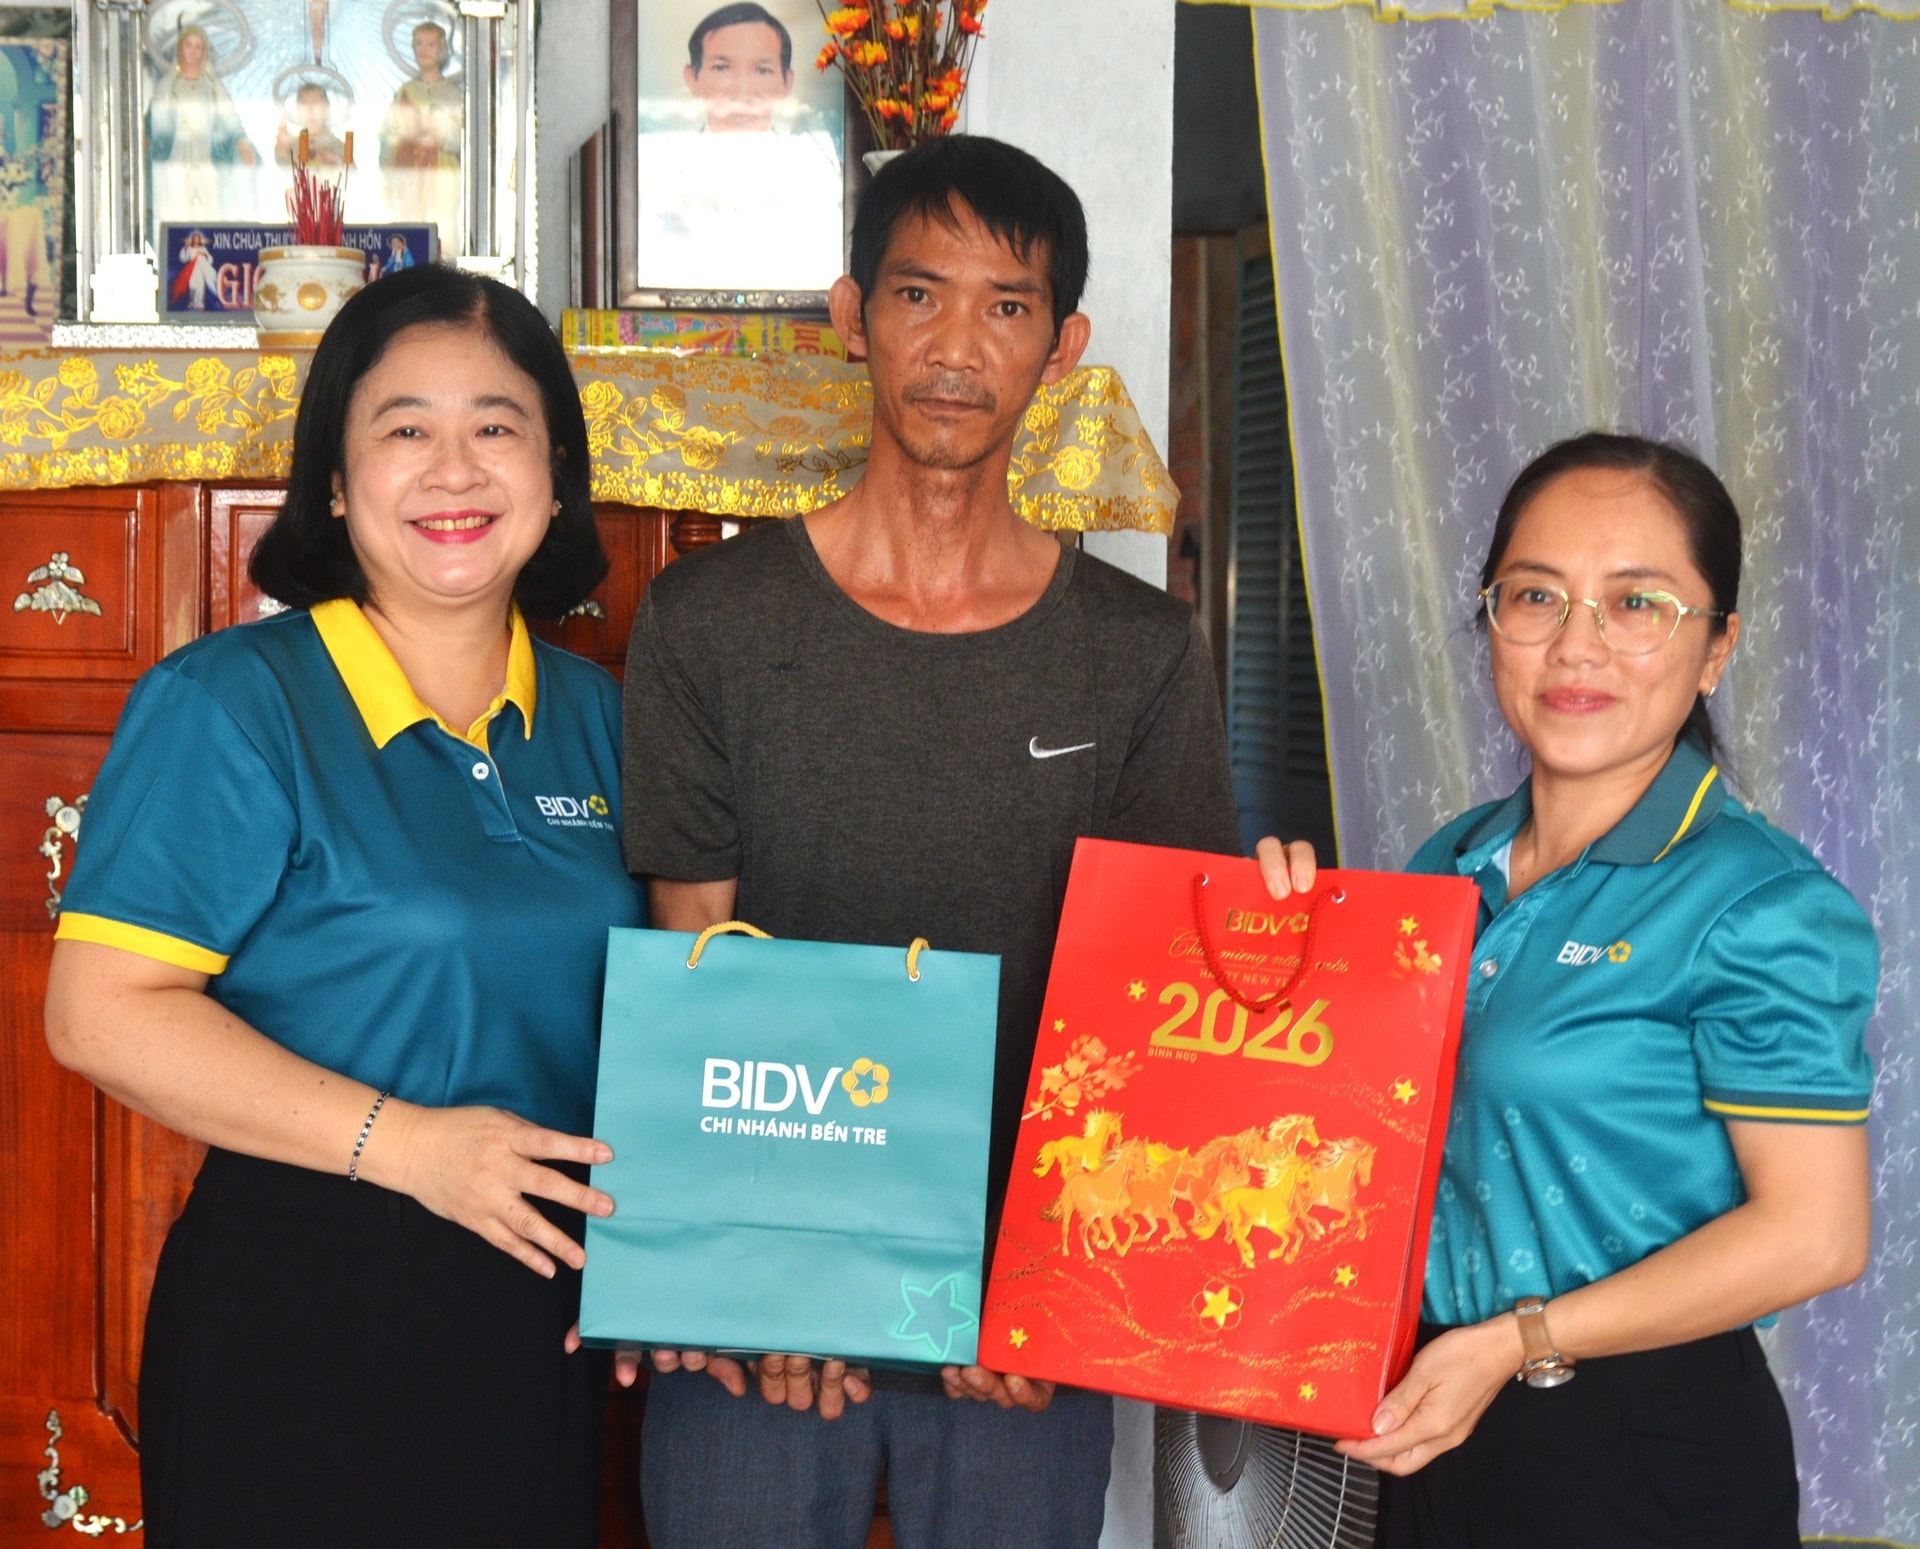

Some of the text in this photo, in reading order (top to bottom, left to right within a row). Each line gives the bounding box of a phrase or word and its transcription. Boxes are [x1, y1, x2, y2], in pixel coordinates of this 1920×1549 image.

[212, 231, 231, 250] XIN
[232, 228, 262, 250] CHÚA
[534, 795, 590, 819] BIDV
[1225, 908, 1289, 936] BIDV
[1555, 940, 1612, 967] BIDV
[1242, 972, 1271, 986] NEW
[1149, 981, 1335, 1068] 2026
[702, 1057, 844, 1116] BIDV
[700, 1115, 887, 1146] CHI NHÁNH BẾN TRE
